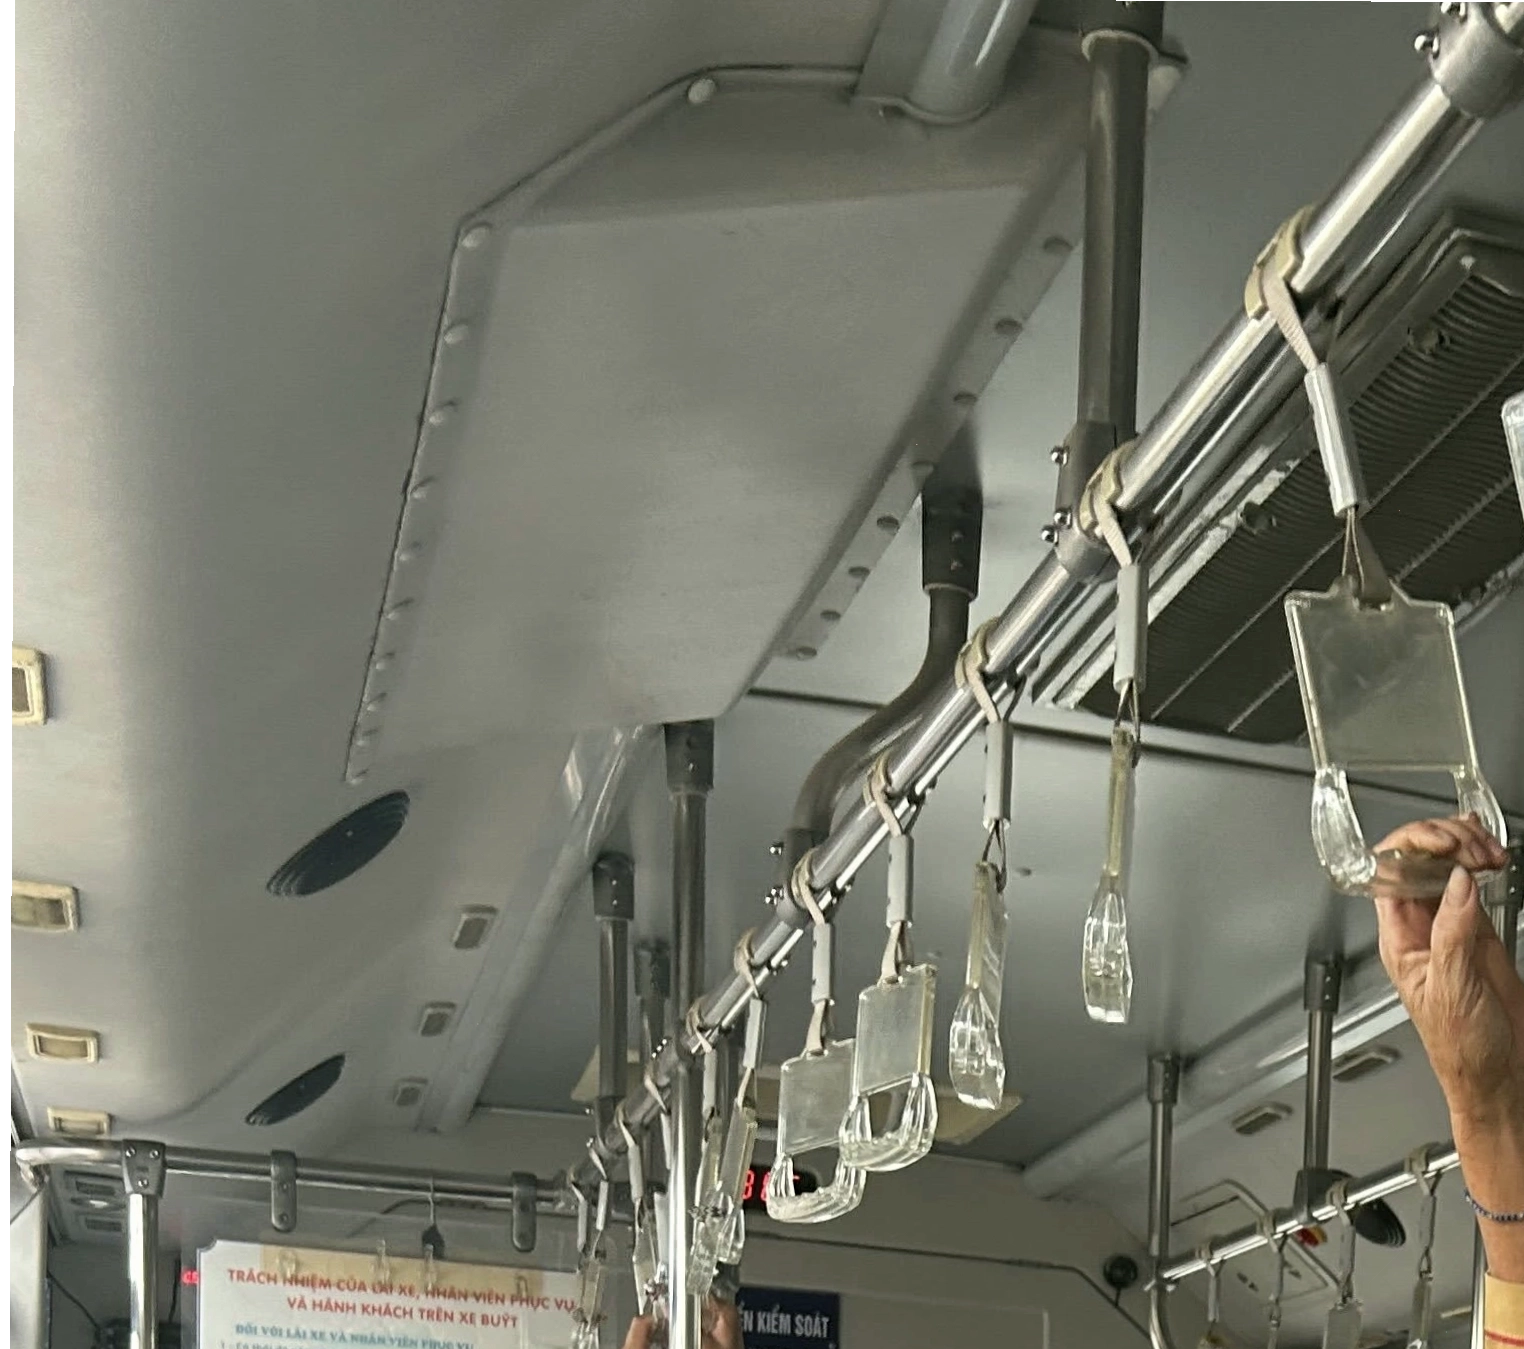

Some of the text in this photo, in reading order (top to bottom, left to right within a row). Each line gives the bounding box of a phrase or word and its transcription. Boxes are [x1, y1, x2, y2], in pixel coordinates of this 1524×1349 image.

[227, 1268, 277, 1285] TRÁCH
[336, 1278, 367, 1293] CỦA
[425, 1284, 468, 1300] NHÂN
[472, 1290, 505, 1304] VIÊN
[286, 1295, 517, 1328] VÀ HÀNH KHÁCH TRÊN XE BUÝT
[757, 1303, 791, 1335] KIỂM
[795, 1310, 830, 1338] SOÁT
